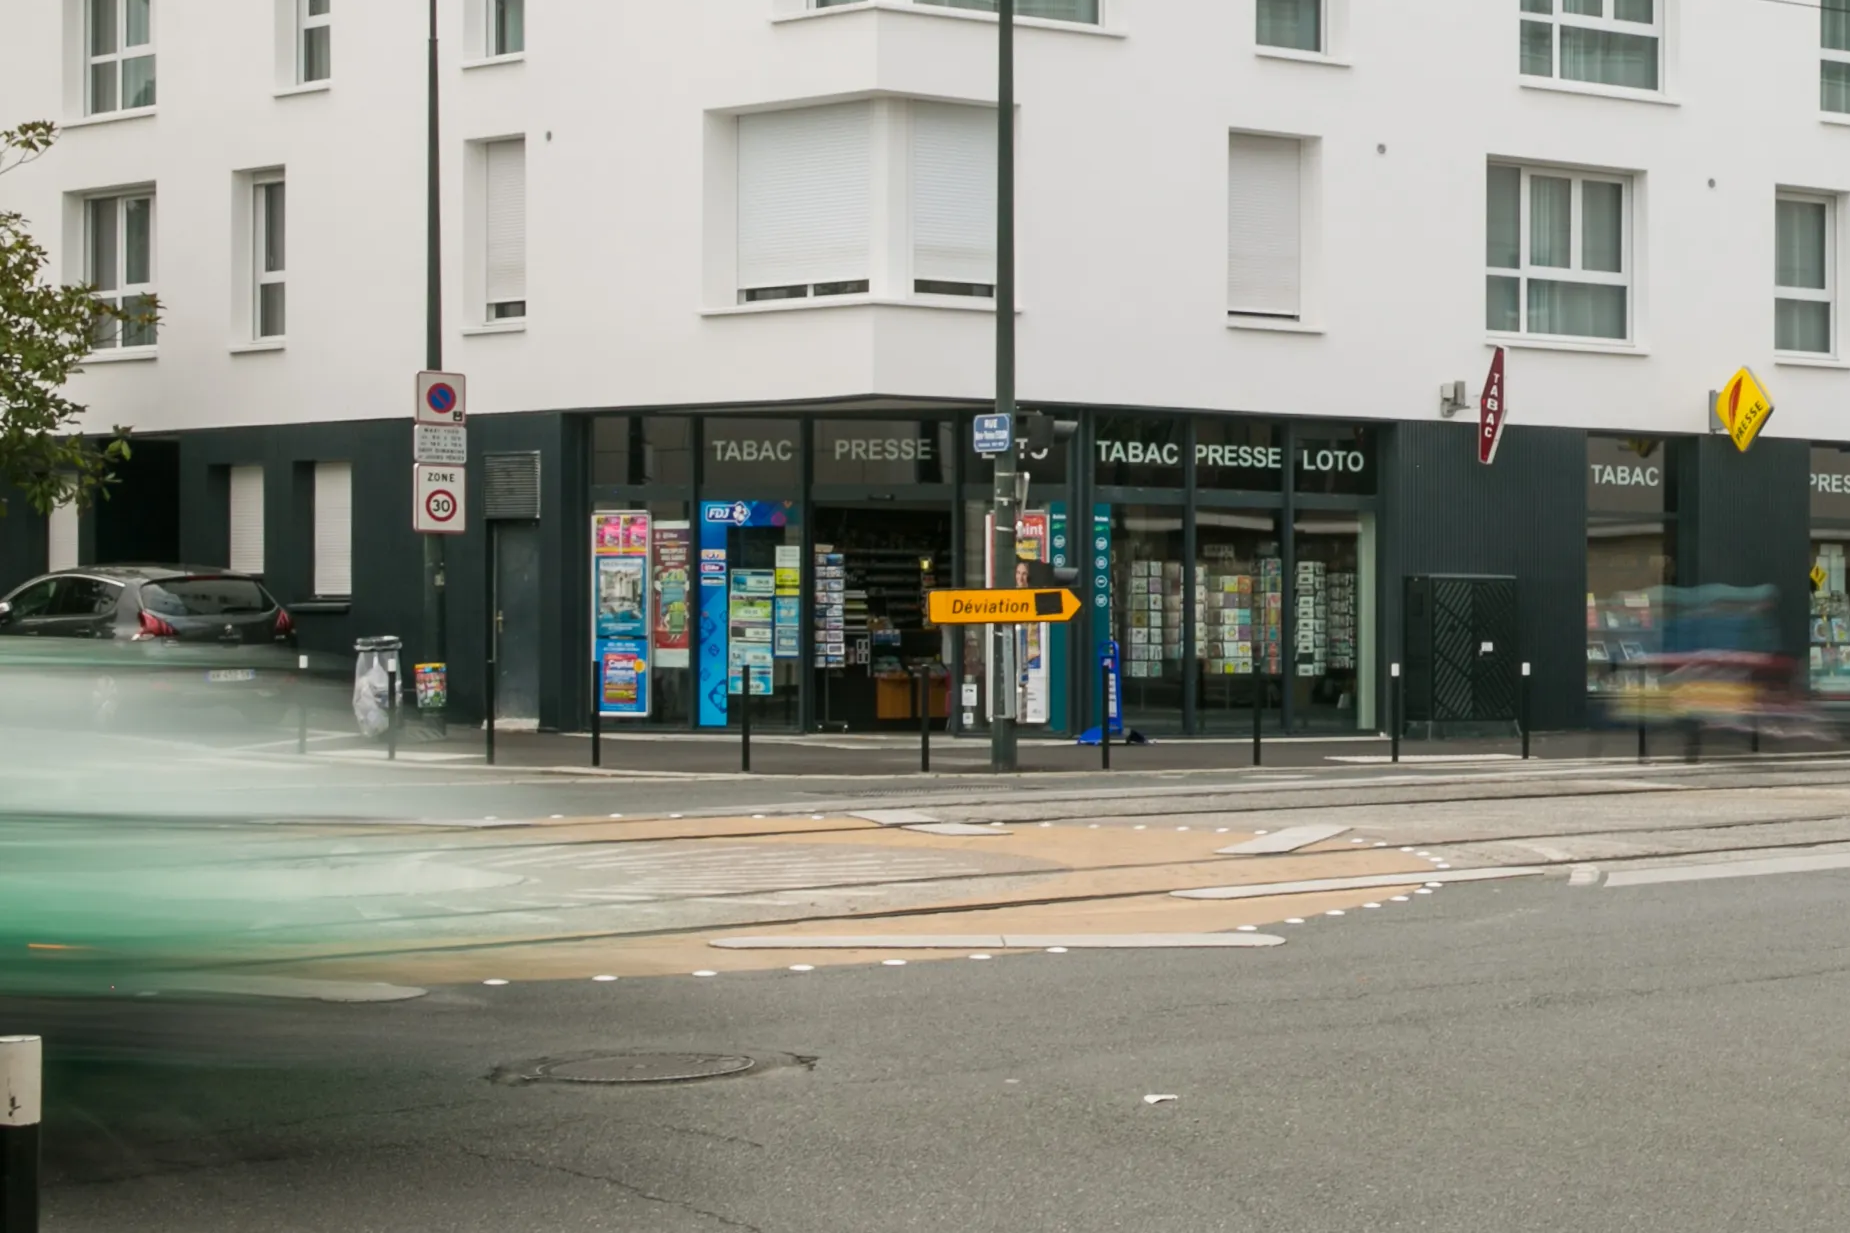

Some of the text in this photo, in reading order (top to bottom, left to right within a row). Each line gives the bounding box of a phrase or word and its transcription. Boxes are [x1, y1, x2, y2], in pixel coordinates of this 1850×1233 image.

[1484, 372, 1500, 438] TABAC
[1735, 400, 1764, 441] PRESSE
[712, 438, 933, 462] TABAC PRESSE
[1096, 440, 1365, 472] TABAC PRESSE LOTO
[427, 472, 456, 483] ZONE
[1591, 463, 1660, 487] TABAC
[432, 499, 450, 512] 30
[708, 508, 730, 519] FDJ
[952, 598, 1030, 615] Déviation
